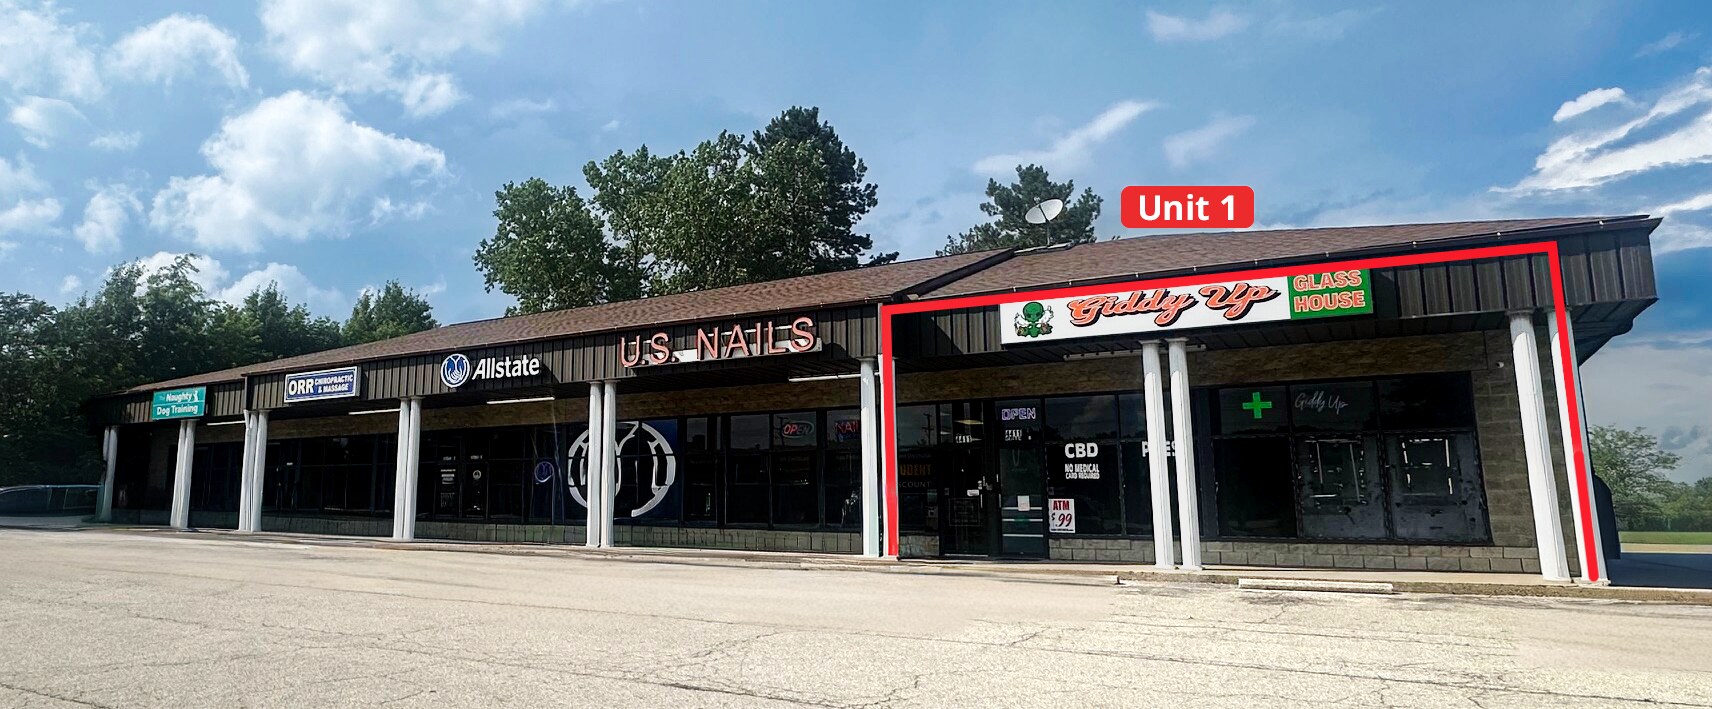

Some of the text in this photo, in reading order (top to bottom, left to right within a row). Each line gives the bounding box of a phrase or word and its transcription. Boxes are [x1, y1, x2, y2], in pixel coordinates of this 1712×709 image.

[1293, 269, 1362, 292] GLASS
[1067, 282, 1281, 327] Giddy Up
[1294, 290, 1366, 313] HOUSE
[620, 316, 815, 367] U.S. NAILS
[471, 354, 540, 381] Allstate
[288, 378, 315, 396] ORR
[315, 374, 354, 386] CHIROPRACTIC
[323, 383, 350, 393] MASSAGE
[166, 391, 193, 403] Naughty
[1294, 390, 1349, 416] Giddy Up
[156, 404, 199, 417] Dog Training
[1001, 407, 1036, 421] OPEN
[783, 423, 811, 436] OPEN
[1064, 442, 1099, 459] CBD
[1064, 463, 1100, 473] NO MEDICAL
[1052, 500, 1070, 511] ATM
